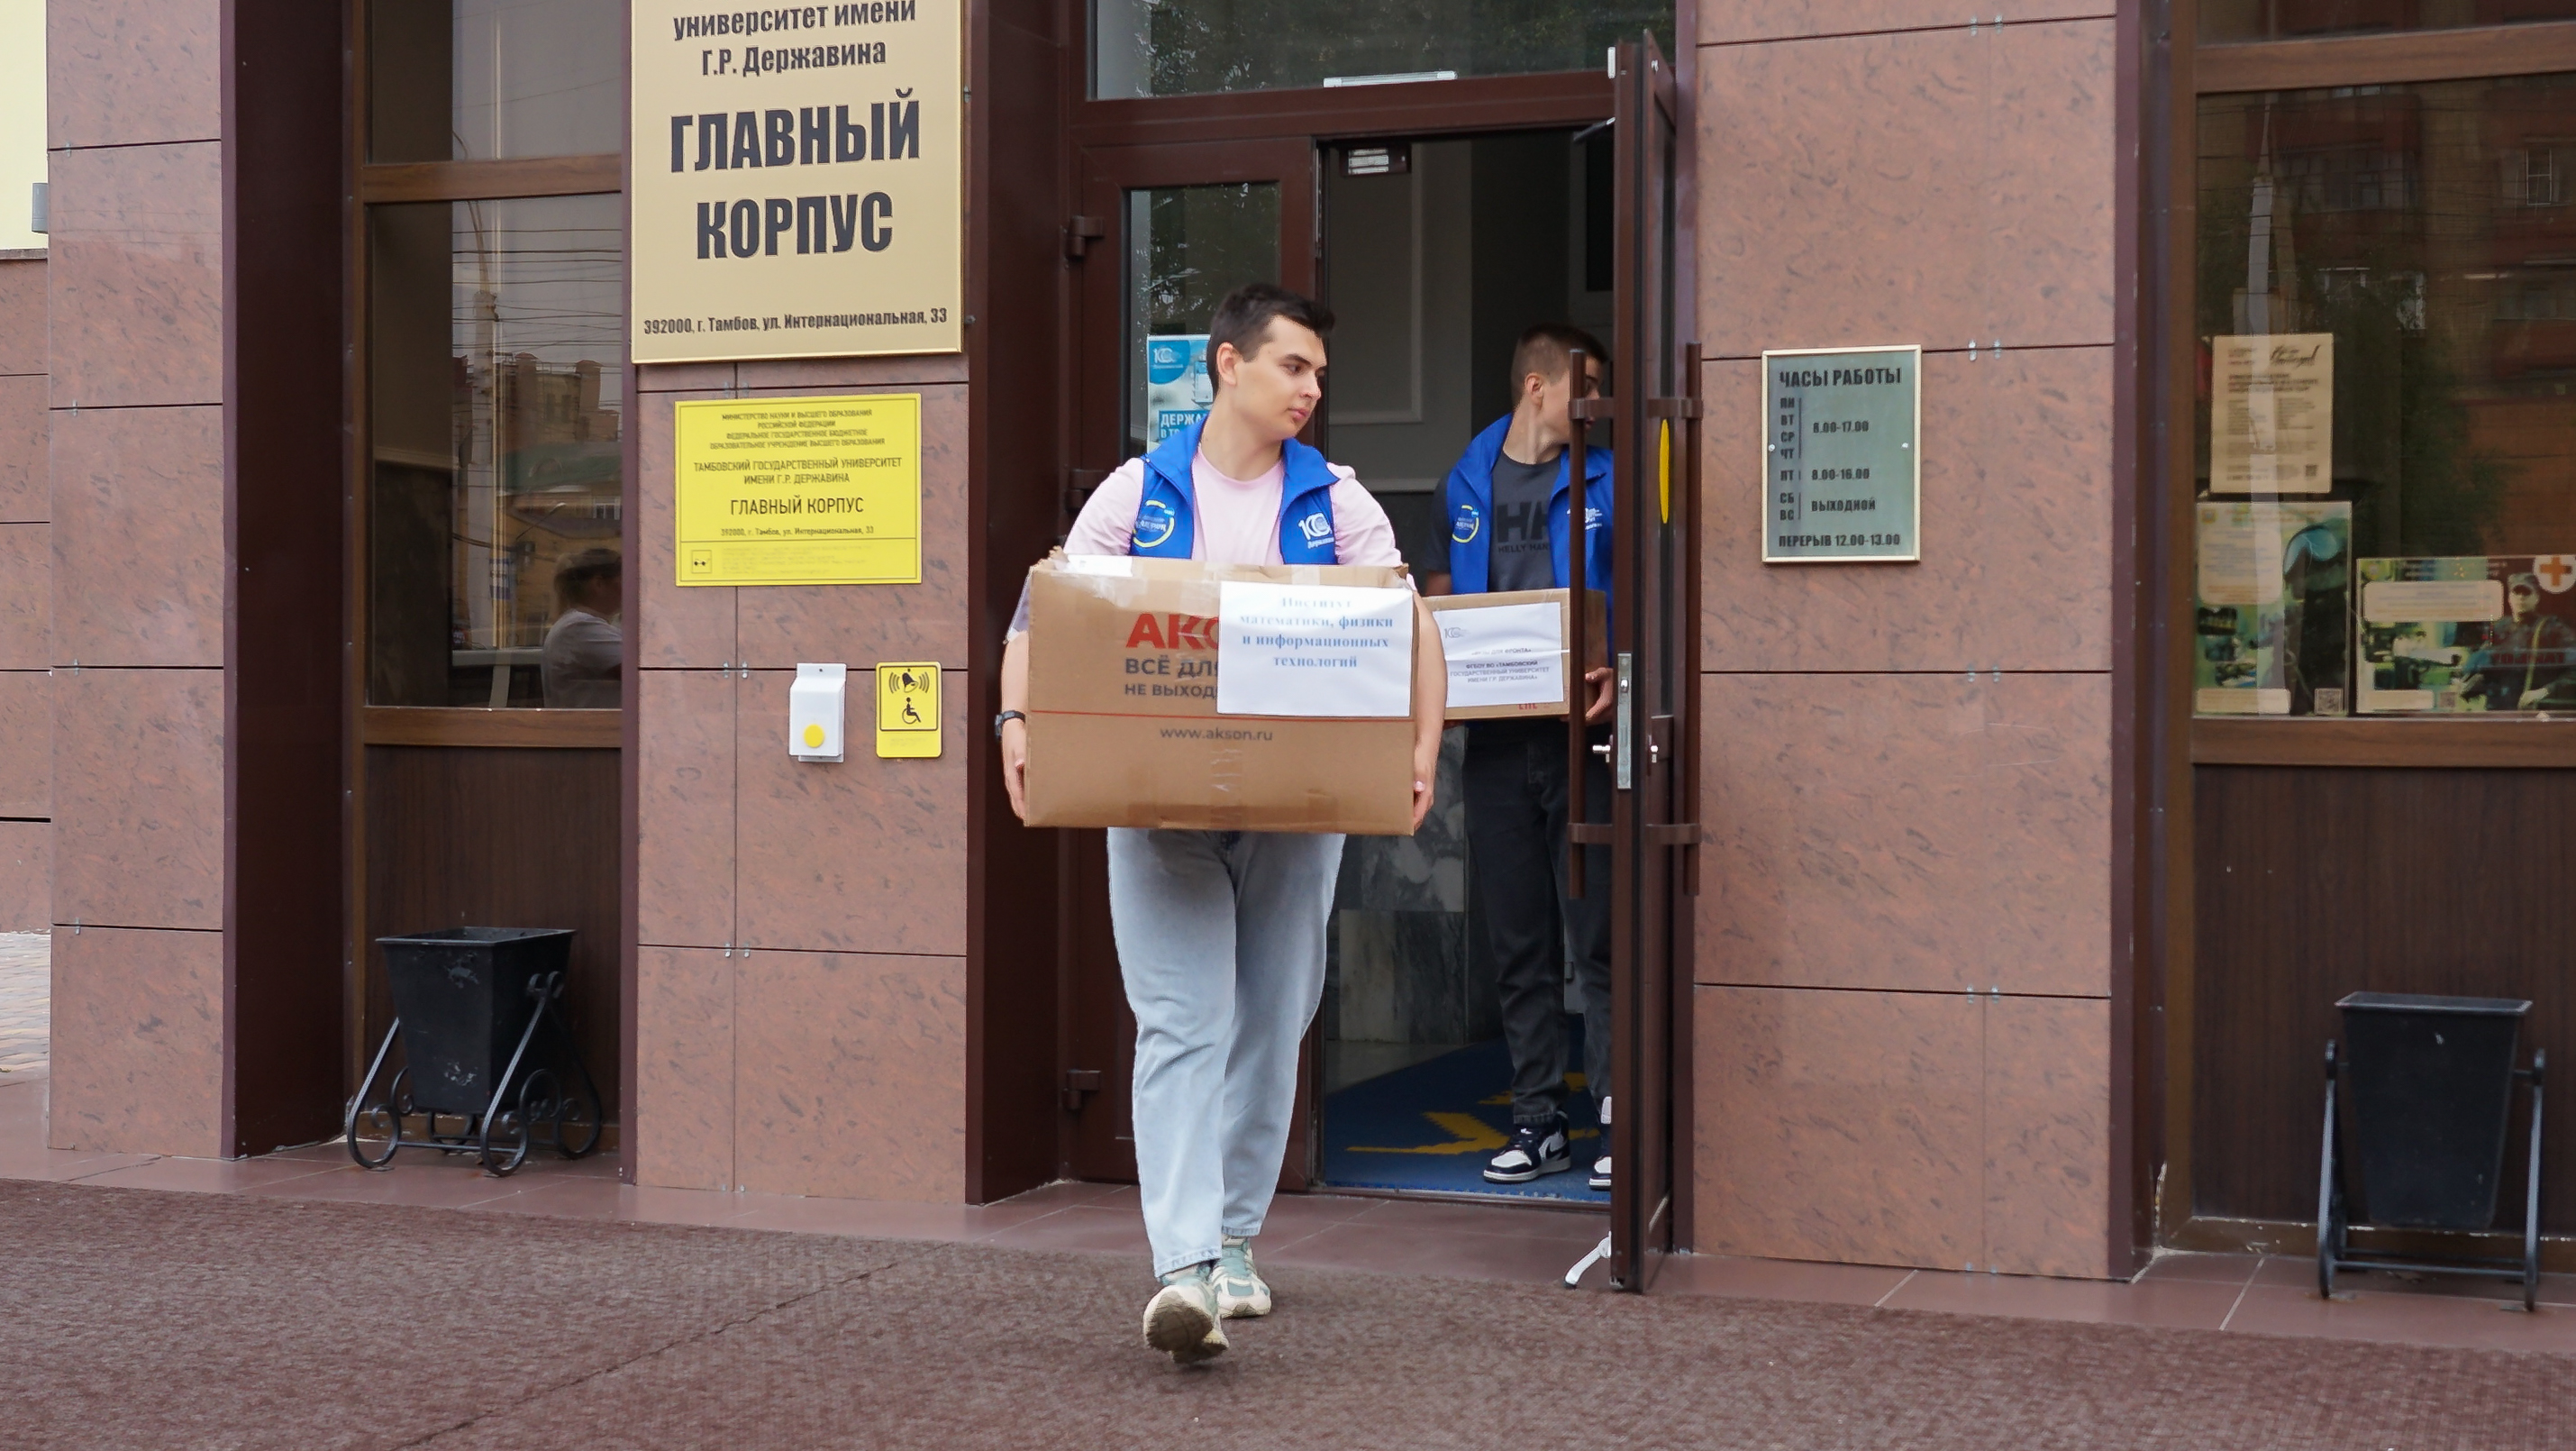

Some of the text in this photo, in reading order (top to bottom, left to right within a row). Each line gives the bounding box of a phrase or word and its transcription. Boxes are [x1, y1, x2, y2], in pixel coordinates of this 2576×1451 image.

[673, 0, 915, 41] университет имени
[702, 41, 886, 77] Г.Р. Державина
[670, 87, 920, 173] ГЛАВНЫЙ
[696, 191, 892, 260] КОРПУС
[643, 307, 948, 334] 392000, г. Тамбов, ул. Интернациональная, 33
[1780, 368, 1901, 388] ЧАСЫ РАБОТЫ
[1780, 397, 1795, 408] ПН
[722, 413, 767, 421] МИНИСТЕРСТВО
[769, 412, 789, 420] НАУКИ
[797, 410, 827, 418] ВЫСШЕГО
[829, 408, 872, 417] ОБРАЗОВАНИЯ
[1161, 412, 1207, 427] ДЕРЖА
[1780, 415, 1795, 425] ВТ
[758, 420, 836, 429] РОССИЙСКОЙ ФЕДЕРАЦИИ
[726, 428, 868, 440] ФЕДЕРАЛЬНОЕ ГОСУДАРСТВЕННОЕ БЮДЖЕТНОЕ
[1780, 432, 1795, 443] СР
[710, 438, 885, 450] ОБРАЗОВАТЕЛЬНОЕ УЧРЕЖДЕНИЕ ВЫСШЕГО ОБРАЗОВАНИЯ
[1780, 448, 1794, 460] ЧТ
[694, 457, 902, 472] ТАМБОВСКИЙ ГОСУДАРСТВЕННЫЙ УНИВЕРСИТЕТ
[743, 473, 850, 485] ИМЕНИ Г.Р. ДЕРЖАВИНА
[1780, 470, 1794, 481] ПТ
[1811, 468, 1870, 480] 8.00-16.00
[1780, 493, 1795, 504] СБ
[1811, 497, 1876, 513] ВЫХОДНОЙ
[730, 495, 864, 516] ГЛАВНЫЙ КОРПУС
[1780, 509, 1794, 521] ВС
[795, 525, 863, 536] Интернациональная,
[1779, 534, 1901, 547] ПЕРЕРЫВ 12.00-13.00
[1498, 543, 1526, 553] HELLY
[1282, 597, 1352, 609] Институт
[1241, 616, 1393, 630] математики, физики
[1242, 634, 1388, 650] и информационных
[1124, 654, 1170, 675] ВСЁ
[1274, 655, 1357, 668] технологий
[1450, 666, 1550, 677] ГОСУДАРСТВЕННЫЙ УНИВЕРСИТЕТ
[1124, 683, 1217, 700] НЕ ВЫХОД
[1160, 727, 1273, 742] www.akson.ru
